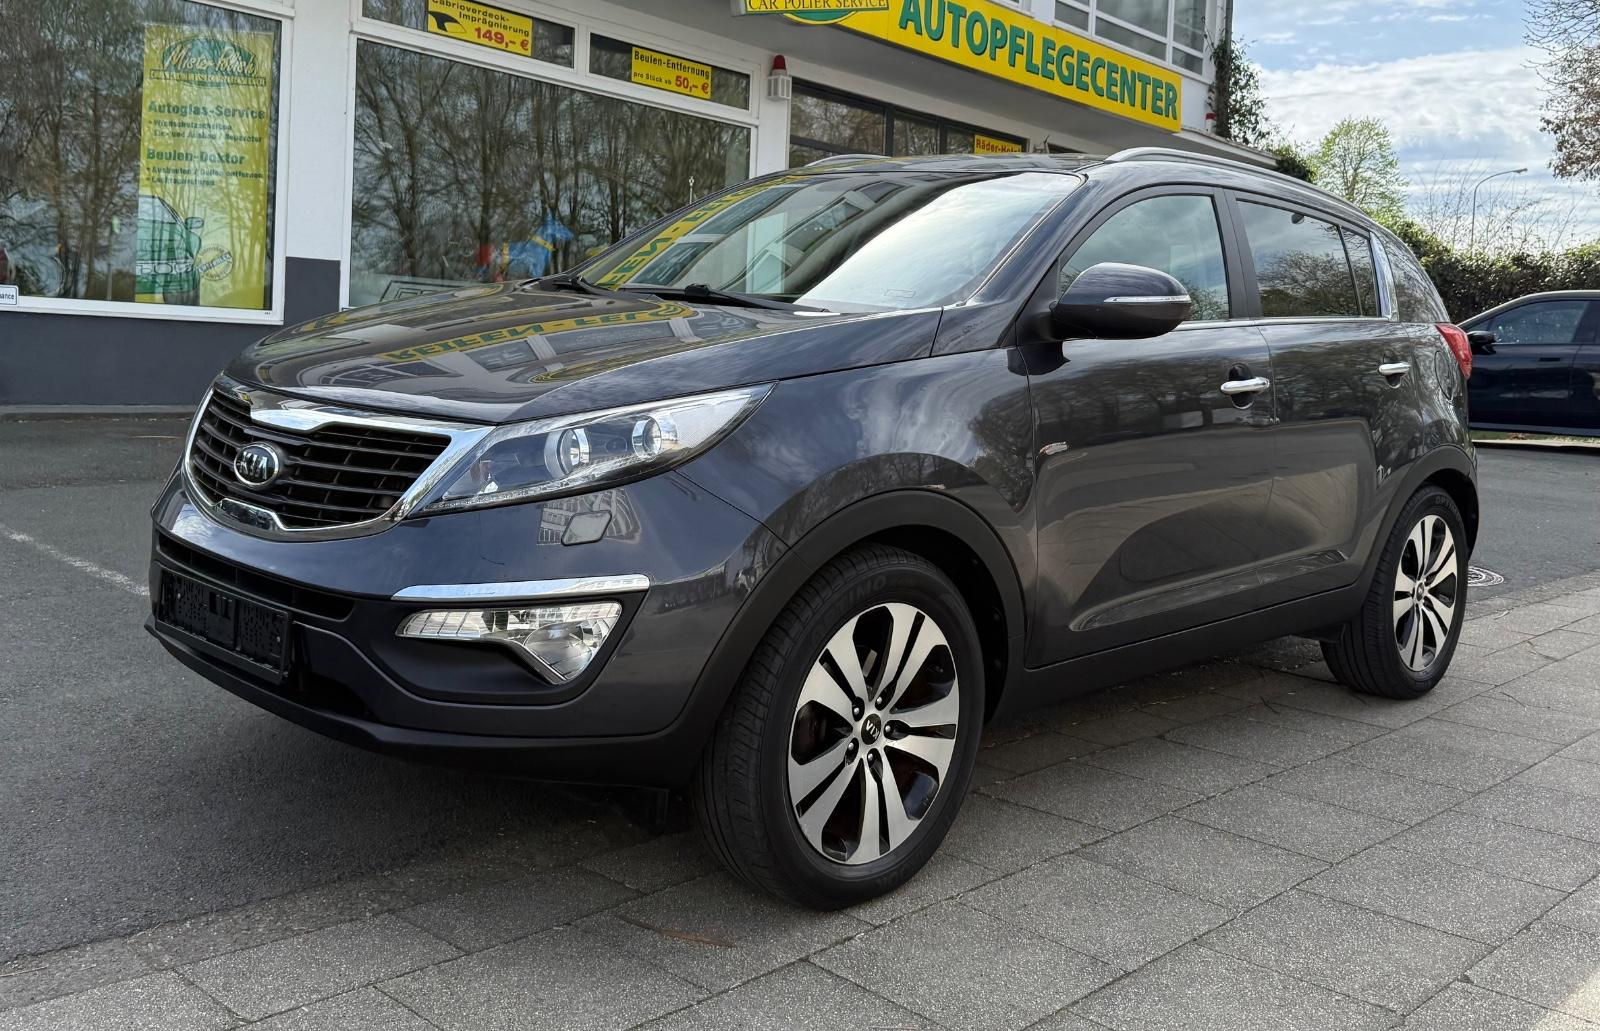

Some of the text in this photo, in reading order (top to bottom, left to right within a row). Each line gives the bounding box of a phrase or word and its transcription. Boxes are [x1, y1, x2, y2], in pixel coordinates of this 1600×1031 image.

[459, 11, 530, 37] Imprägnierung
[520, 39, 530, 51] €
[634, 50, 710, 80] Beulen-Entfernung
[898, 0, 1178, 120] AUTOPFLEGECENTER
[701, 82, 710, 95] €
[148, 101, 266, 120] Autoglas-Service
[146, 148, 246, 165] Beulen-Doktor
[239, 451, 269, 481] KIA
